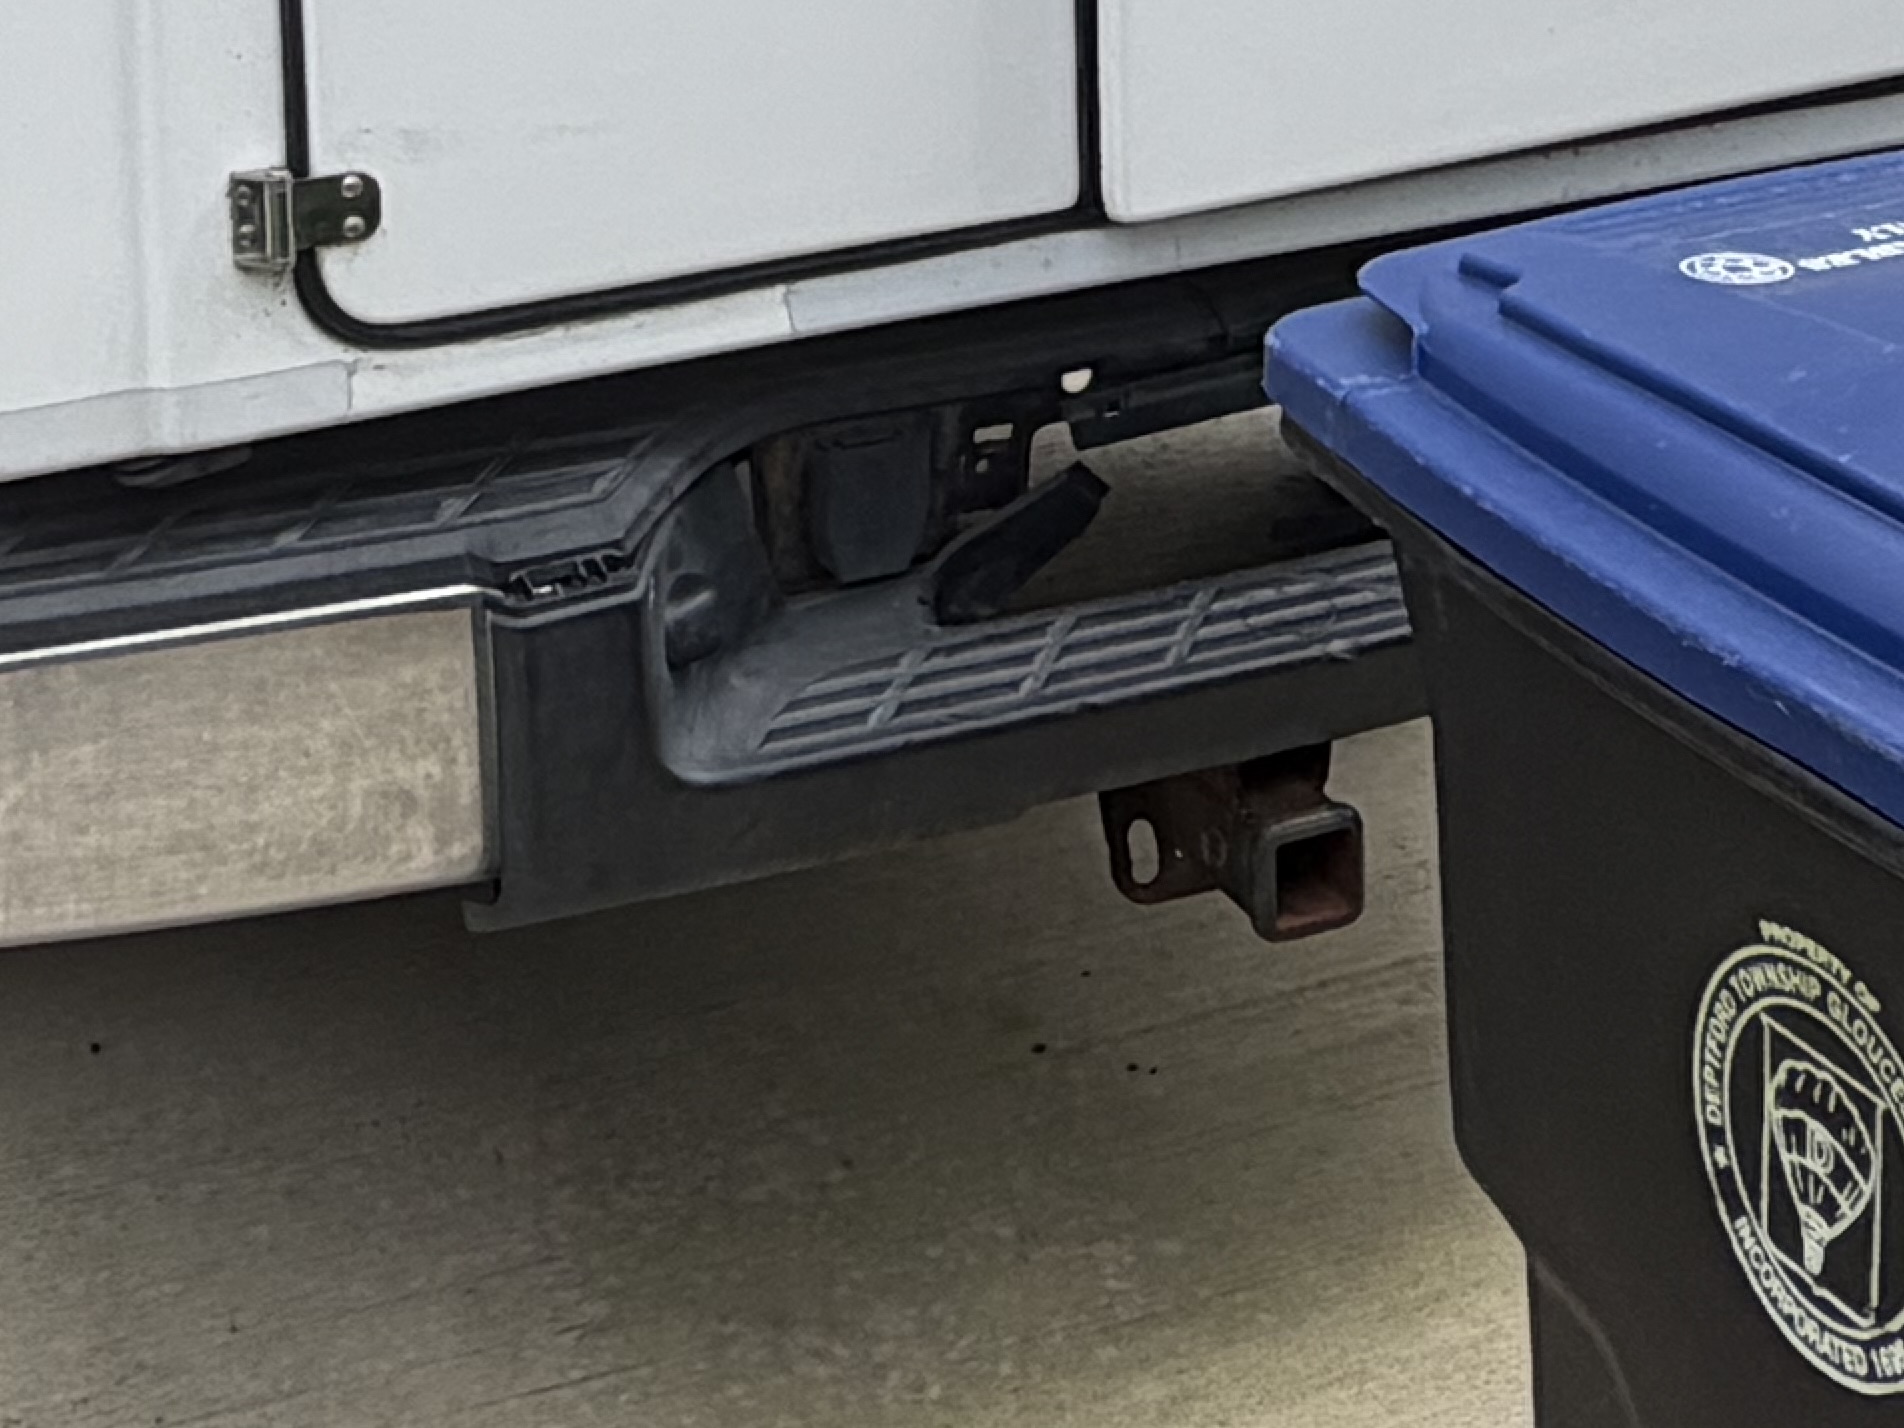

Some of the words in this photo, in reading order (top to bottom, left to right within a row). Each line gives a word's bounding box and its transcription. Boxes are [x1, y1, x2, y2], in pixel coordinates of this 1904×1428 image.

[1758, 918, 1853, 985] PROPERTY
[1702, 988, 1737, 1126] DEPTFORD
[1728, 962, 1822, 1002] TOWNSHIP
[1732, 1214, 1867, 1377] INCORPORATED
